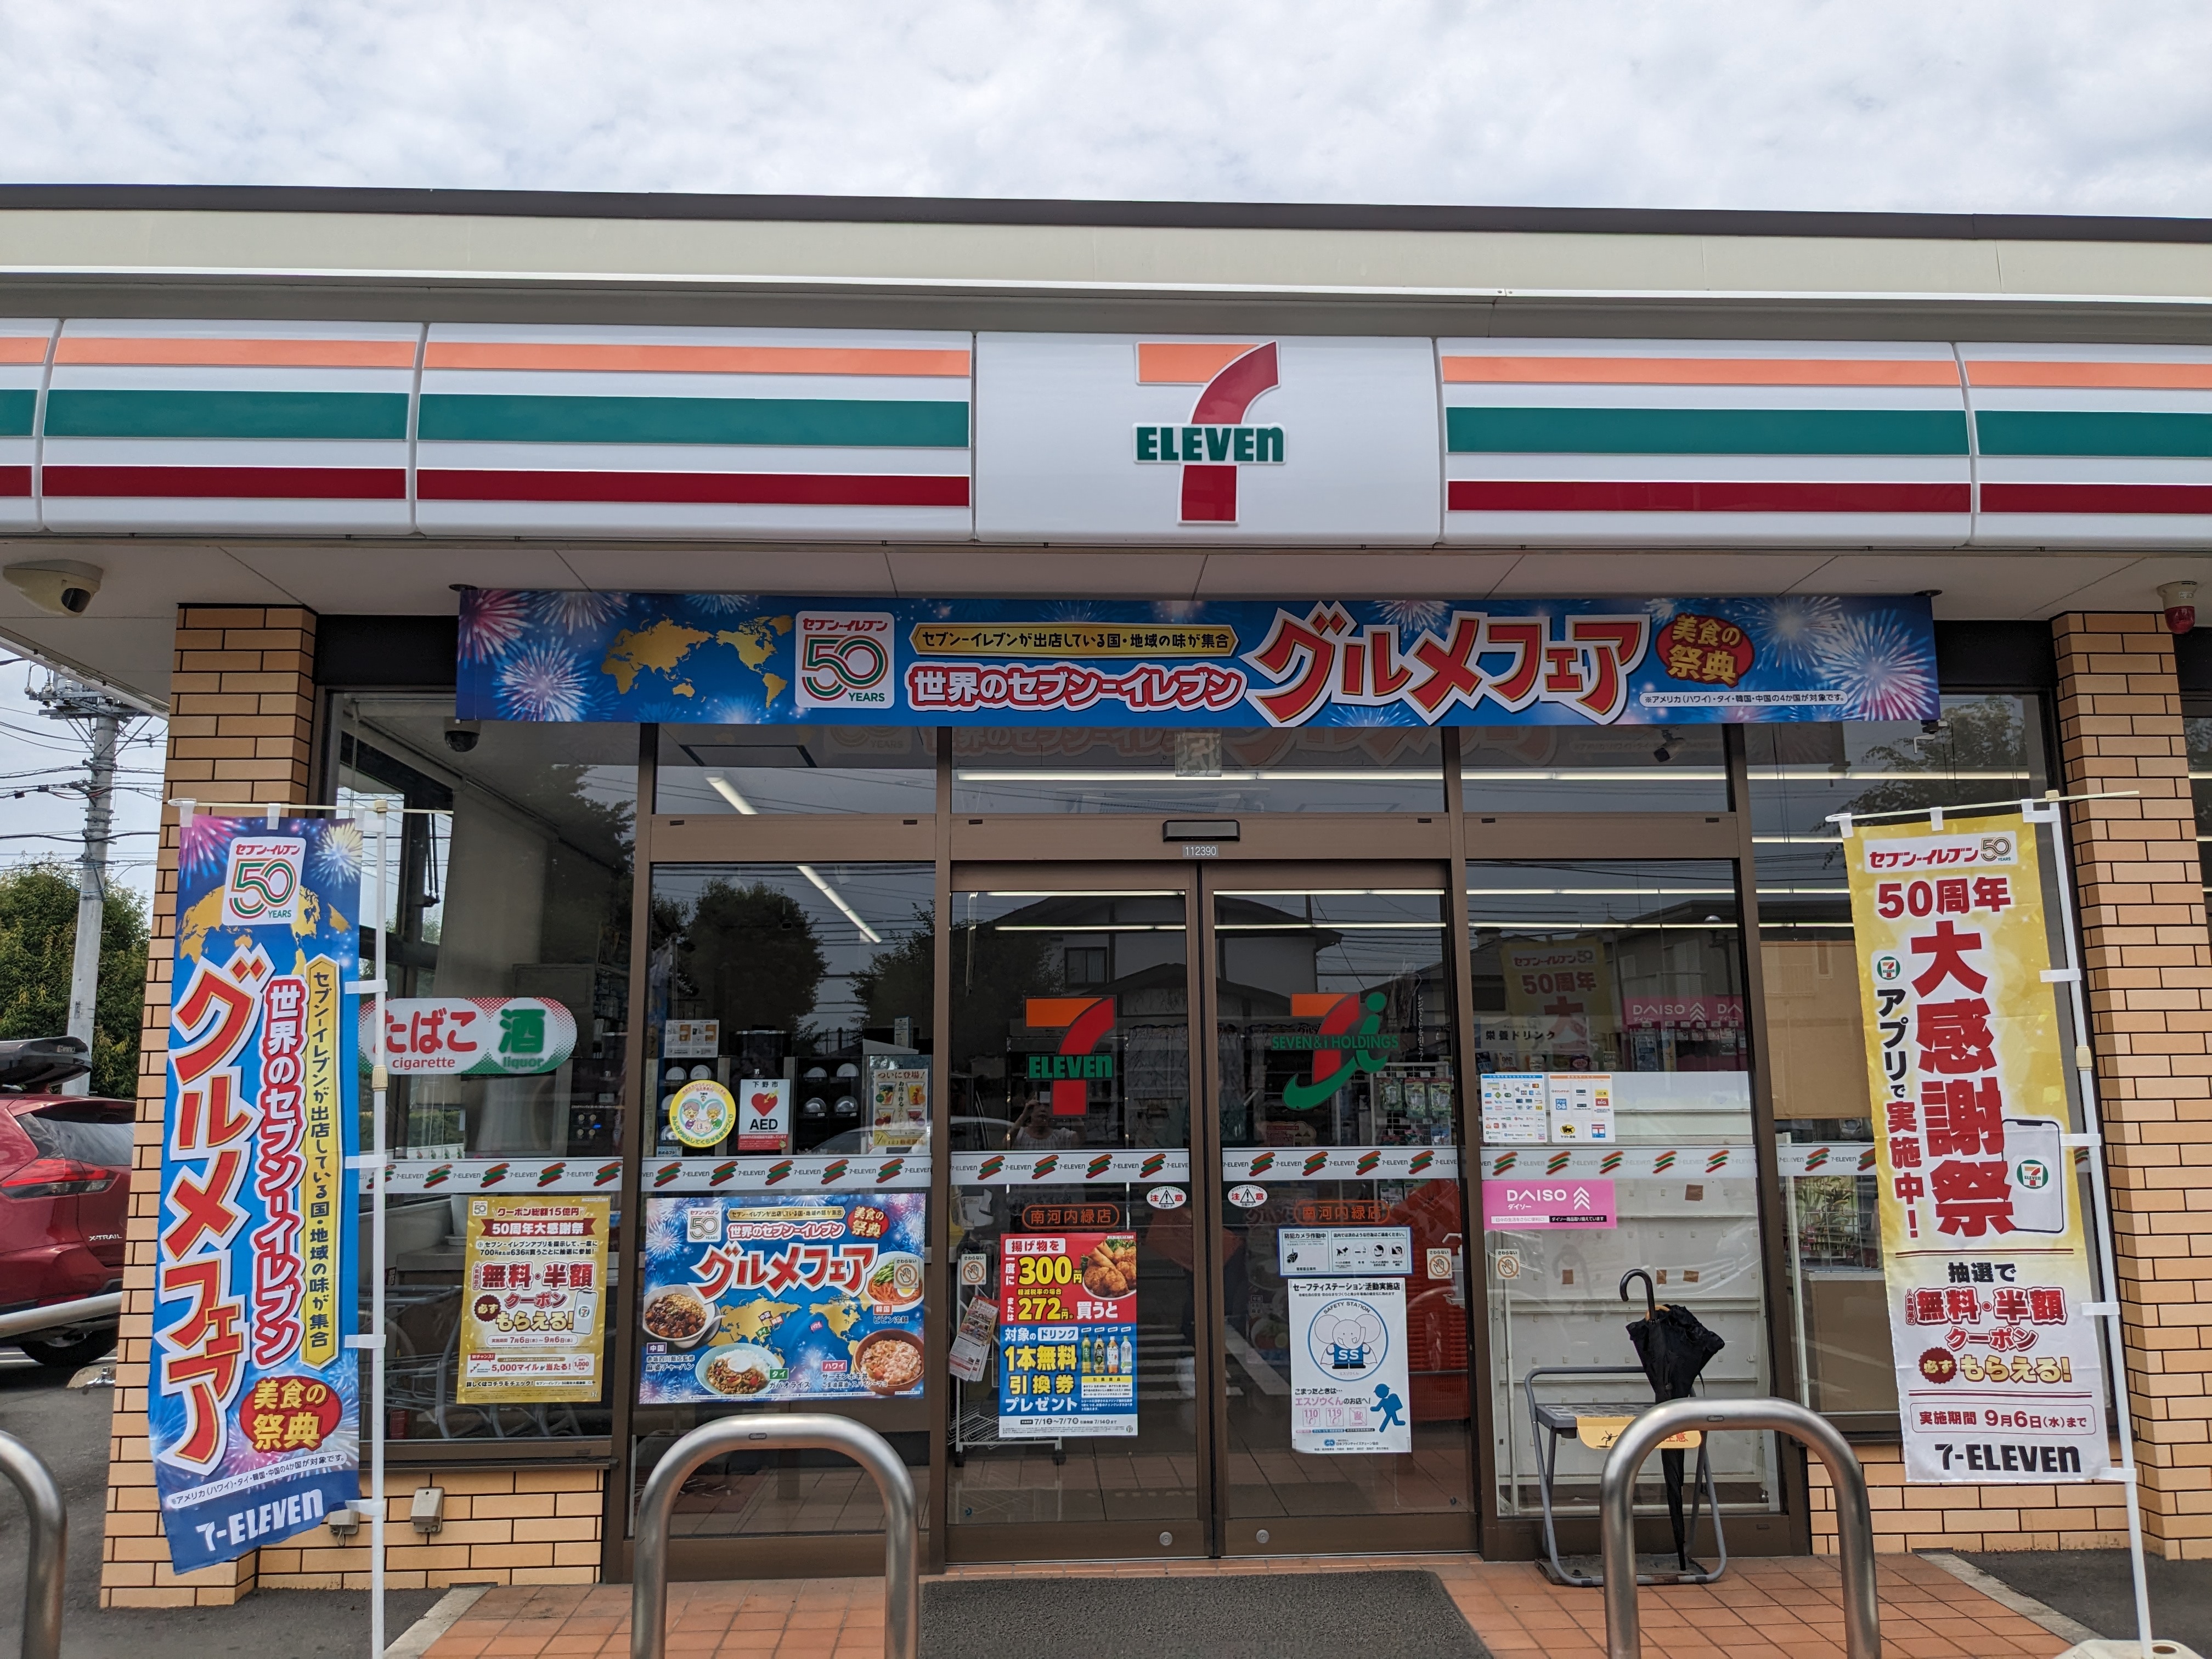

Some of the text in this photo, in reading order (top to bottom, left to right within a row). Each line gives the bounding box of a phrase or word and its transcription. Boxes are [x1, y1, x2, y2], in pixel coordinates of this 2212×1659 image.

[1672, 615, 1741, 647] 美食の
[802, 634, 889, 701] 50
[1251, 607, 1645, 724] グルメフェア
[1668, 646, 1737, 685] 祭典
[848, 692, 885, 702] YEARS
[1185, 847, 1217, 856] 112390
[1980, 837, 2011, 861] 50
[230, 857, 297, 919] 50
[1877, 877, 2011, 918] 50周年
[268, 910, 292, 919] YEARS
[1521, 971, 1596, 995] 50周年
[1632, 1004, 1686, 1015] DAISO
[373, 1007, 477, 1054] たばこ
[499, 1008, 546, 1053] 酒
[1486, 1030, 1555, 1040] 栄養ドリンク
[1331, 1035, 1398, 1049] HOLDINGS
[392, 1057, 455, 1070] cigarette
[503, 1056, 544, 1069] liquor
[878, 1071, 926, 1079] ついに登場!
[1910, 920, 2017, 1238] 大感謝祭
[749, 1118, 778, 1131] AED
[1506, 1189, 1567, 1202] DAISO
[163, 956, 267, 1465] グルメフェア
[854, 1206, 884, 1221] 美食の
[1030, 1209, 1111, 1224] 南河内緑店
[1302, 1205, 1383, 1221] 南河内緑店
[492, 1222, 584, 1235] 50周年大感謝祭
[690, 1216, 719, 1239] 50
[851, 1220, 882, 1238] 祭典
[89, 1233, 122, 1242] X-TRAIL
[1011, 1240, 1059, 1252] 揚げ物を
[481, 1261, 596, 1290] 無料・半額
[695, 1244, 874, 1300] グルメフェア
[1005, 1257, 1015, 1286] 一度に
[1948, 1262, 2016, 1283] 抽選で
[504, 1291, 567, 1308] クーポン
[1323, 1301, 1371, 1314] SAFETY STATION
[1915, 1287, 2067, 1324] 無料・半額
[478, 1304, 498, 1314] 必ず
[1076, 1301, 1119, 1319] 買うと
[495, 1311, 574, 1332] もらえる!
[1040, 1328, 1076, 1340] ドリンク
[1945, 1326, 2039, 1351] クーポン
[650, 1344, 664, 1352] 中国
[1338, 1350, 1359, 1361] SS
[1005, 1344, 1077, 1371] 1本無料
[1923, 1359, 1953, 1373] 必ず
[1960, 1355, 2072, 1383] もらえる!
[1009, 1374, 1074, 1395] 引換券
[254, 1379, 327, 1410] 美食の
[1005, 1396, 1077, 1412] プレゼント
[1328, 1409, 1342, 1417] 119
[1304, 1409, 1319, 1418] 110
[1920, 1409, 2087, 1429] 実施期間 9月6日(水)まで
[253, 1414, 321, 1450] 祭典
